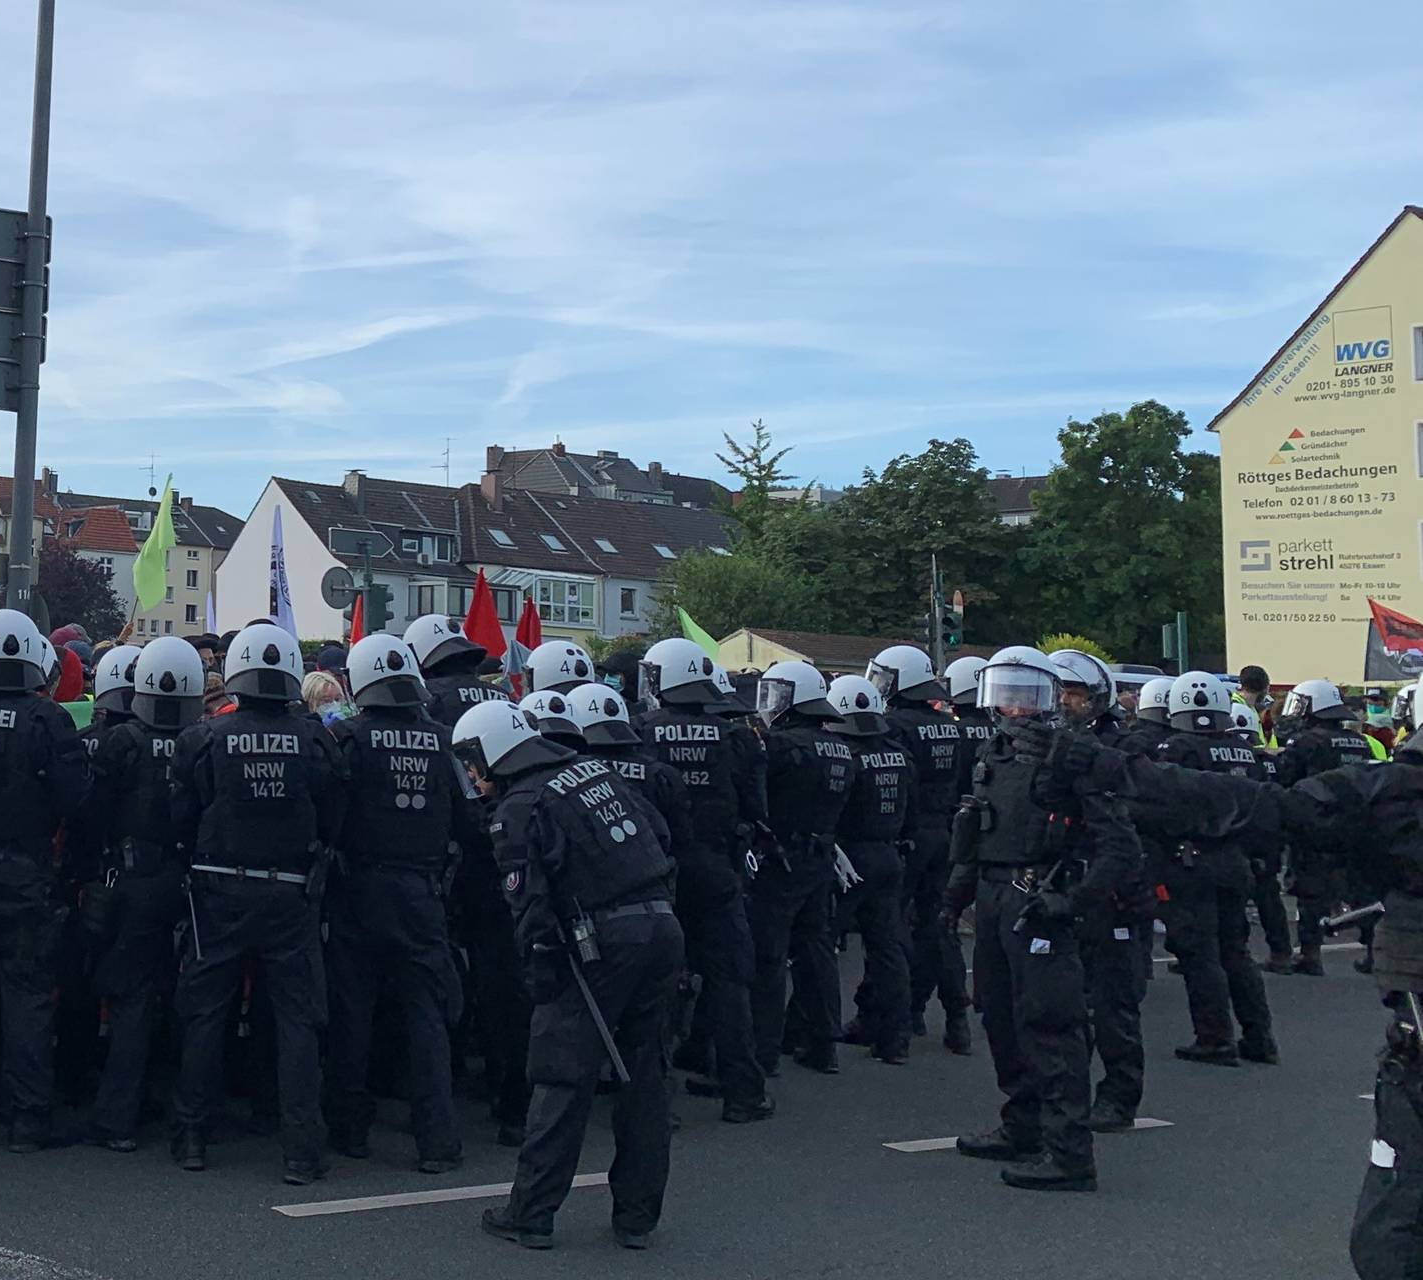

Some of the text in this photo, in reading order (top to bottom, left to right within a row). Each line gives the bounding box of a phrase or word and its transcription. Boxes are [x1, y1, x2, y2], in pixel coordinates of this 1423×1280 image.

[1336, 339, 1390, 362] WVG
[1243, 314, 1331, 407] Ihre Hausverwaltung
[1335, 362, 1393, 377] LANGNER
[1273, 385, 1284, 396] in
[1306, 380, 1330, 392] 0201
[1340, 378, 1360, 389] 895
[1364, 376, 1376, 386] 10
[1380, 374, 1394, 385] 30
[1294, 386, 1396, 402] www.wvg-langner.de
[1310, 427, 1366, 438] Bedachungen
[1291, 452, 1341, 463] Solartechnik
[1238, 464, 1398, 486] Röttges Bedachungen
[1243, 499, 1283, 509] Telefon
[1255, 508, 1383, 520] www.roettges-bedachungen.de
[1278, 538, 1333, 556] parkett
[1279, 554, 1334, 571] strehl
[1242, 612, 1261, 622] Tel.
[433, 623, 444, 636] 4
[23, 637, 30, 654] 1
[241, 646, 296, 668] 4 1
[373, 656, 385, 674] 4
[110, 664, 120, 679] 4
[560, 660, 571, 675] 4
[688, 660, 698, 675] 4
[145, 673, 188, 692] 4 1
[719, 673, 727, 686] 4
[534, 699, 545, 712] 4
[588, 699, 599, 714] 4
[839, 696, 849, 710] 4
[1181, 692, 1190, 705] 6
[512, 714, 524, 731] 4
[654, 725, 720, 742] POLIZEI
[918, 724, 960, 740] POLIZEI
[227, 733, 299, 755] POLIZEI
[371, 730, 440, 752] POLIZEI
[669, 747, 706, 761] NRW
[815, 742, 852, 760] POLIZEI
[1210, 748, 1255, 764] POLIZEI
[390, 756, 429, 773] NRW
[860, 752, 906, 769] POLIZEI
[243, 762, 285, 779] NRW
[547, 759, 610, 795] POLIZEI
[394, 774, 426, 791] 1412
[875, 773, 899, 786] NRW
[251, 781, 286, 798] 1412
[579, 781, 616, 808] NRW
[595, 800, 627, 825] 1412
[880, 802, 895, 814] RH
